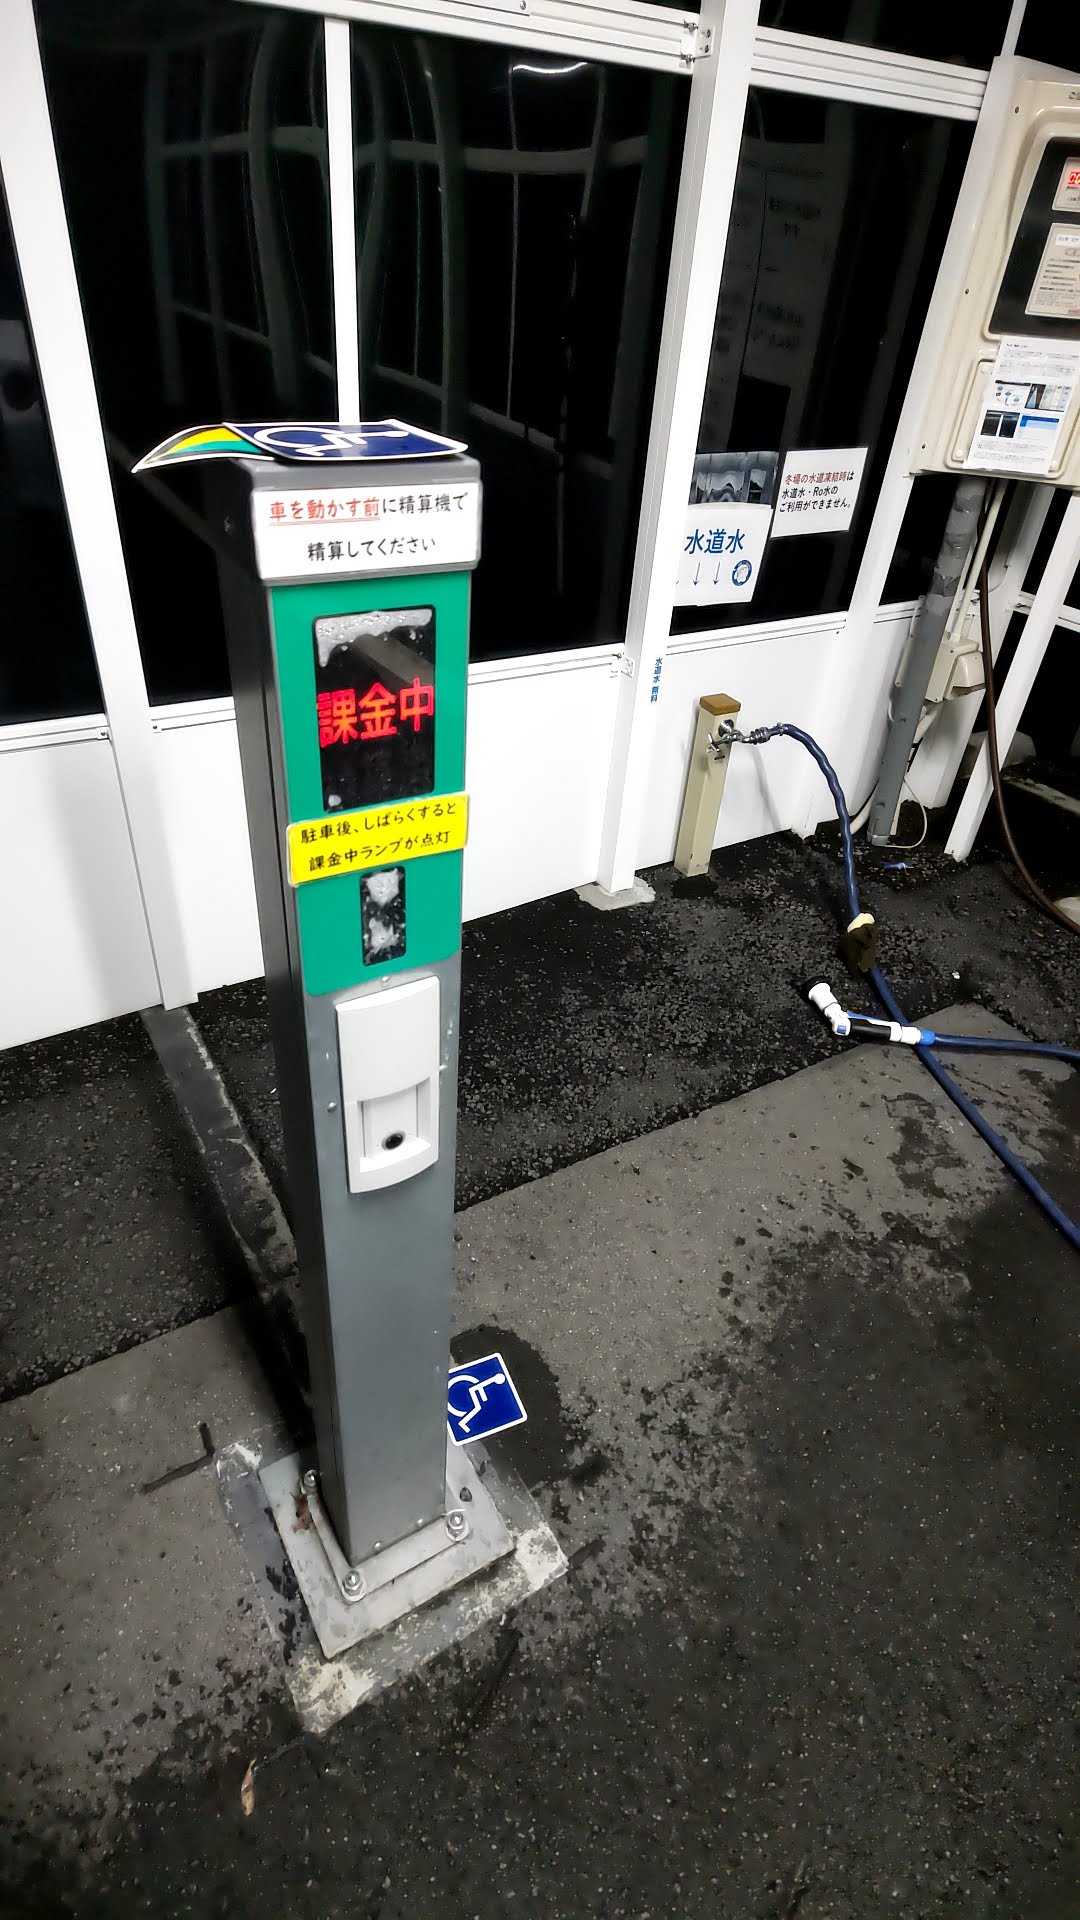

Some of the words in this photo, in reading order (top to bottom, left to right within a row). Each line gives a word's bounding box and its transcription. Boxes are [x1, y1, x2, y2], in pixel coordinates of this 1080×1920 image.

[269, 492, 468, 521] 車を動かす前に精算機で
[779, 497, 851, 512] ご利用ができません。
[307, 537, 436, 561] 精算してください
[684, 528, 746, 554] 水道水
[316, 676, 435, 748] 課金中
[300, 802, 457, 844] 駐車後、しばらくすると
[308, 830, 451, 871] 課金中ランプが点灯
